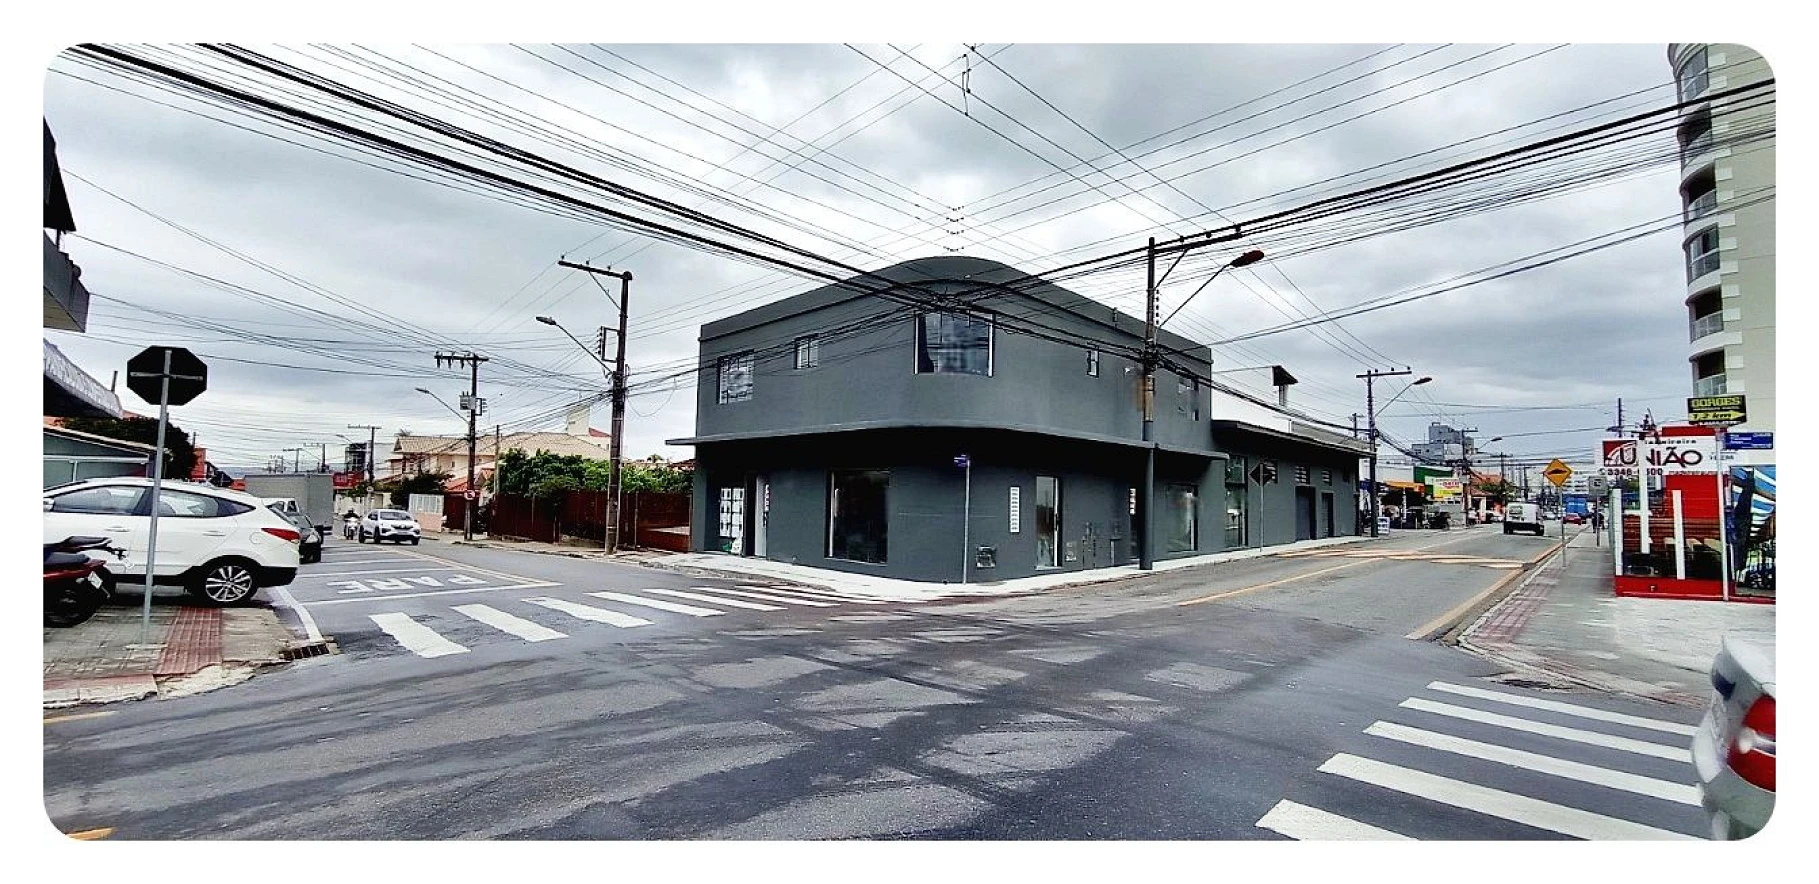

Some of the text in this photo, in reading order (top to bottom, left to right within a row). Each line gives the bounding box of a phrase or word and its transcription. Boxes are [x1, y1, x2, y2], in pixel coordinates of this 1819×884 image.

[1691, 397, 1740, 407] GORGES
[1619, 446, 1703, 468] UNIÃO
[326, 574, 489, 594] PARE
